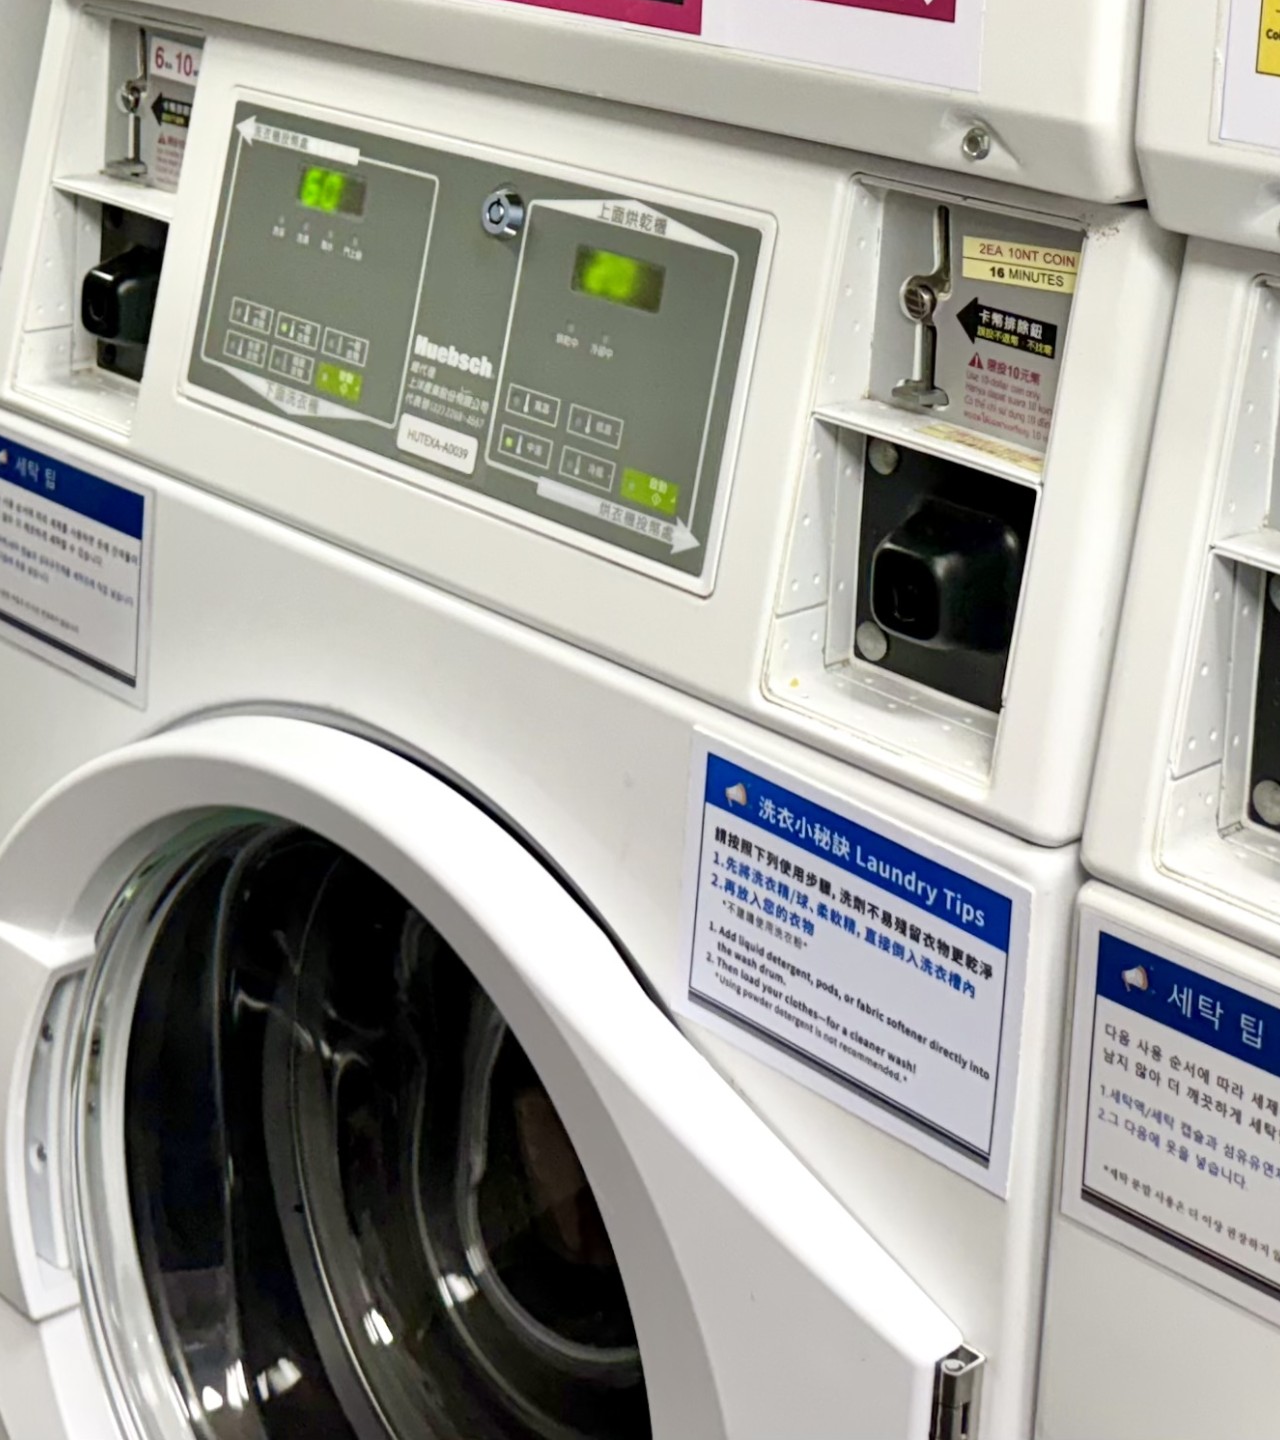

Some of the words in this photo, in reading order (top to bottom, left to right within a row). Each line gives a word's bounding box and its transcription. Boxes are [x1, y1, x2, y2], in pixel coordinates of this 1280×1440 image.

[155, 46, 164, 69] 6
[176, 51, 192, 76] 10
[979, 243, 1003, 256] 2EA
[1009, 247, 1039, 262] 10NT
[1043, 252, 1076, 268] COIN
[989, 266, 1005, 278] 16
[1009, 268, 1064, 287] MINUTES
[414, 334, 493, 379] Huebsch
[757, 794, 851, 862] 洗衣小秘訣
[856, 845, 938, 904] Laundry
[943, 888, 986, 928] Tips
[719, 924, 737, 943] Add
[1167, 983, 1224, 1032] 세탁
[1240, 1009, 1264, 1050] 팁
